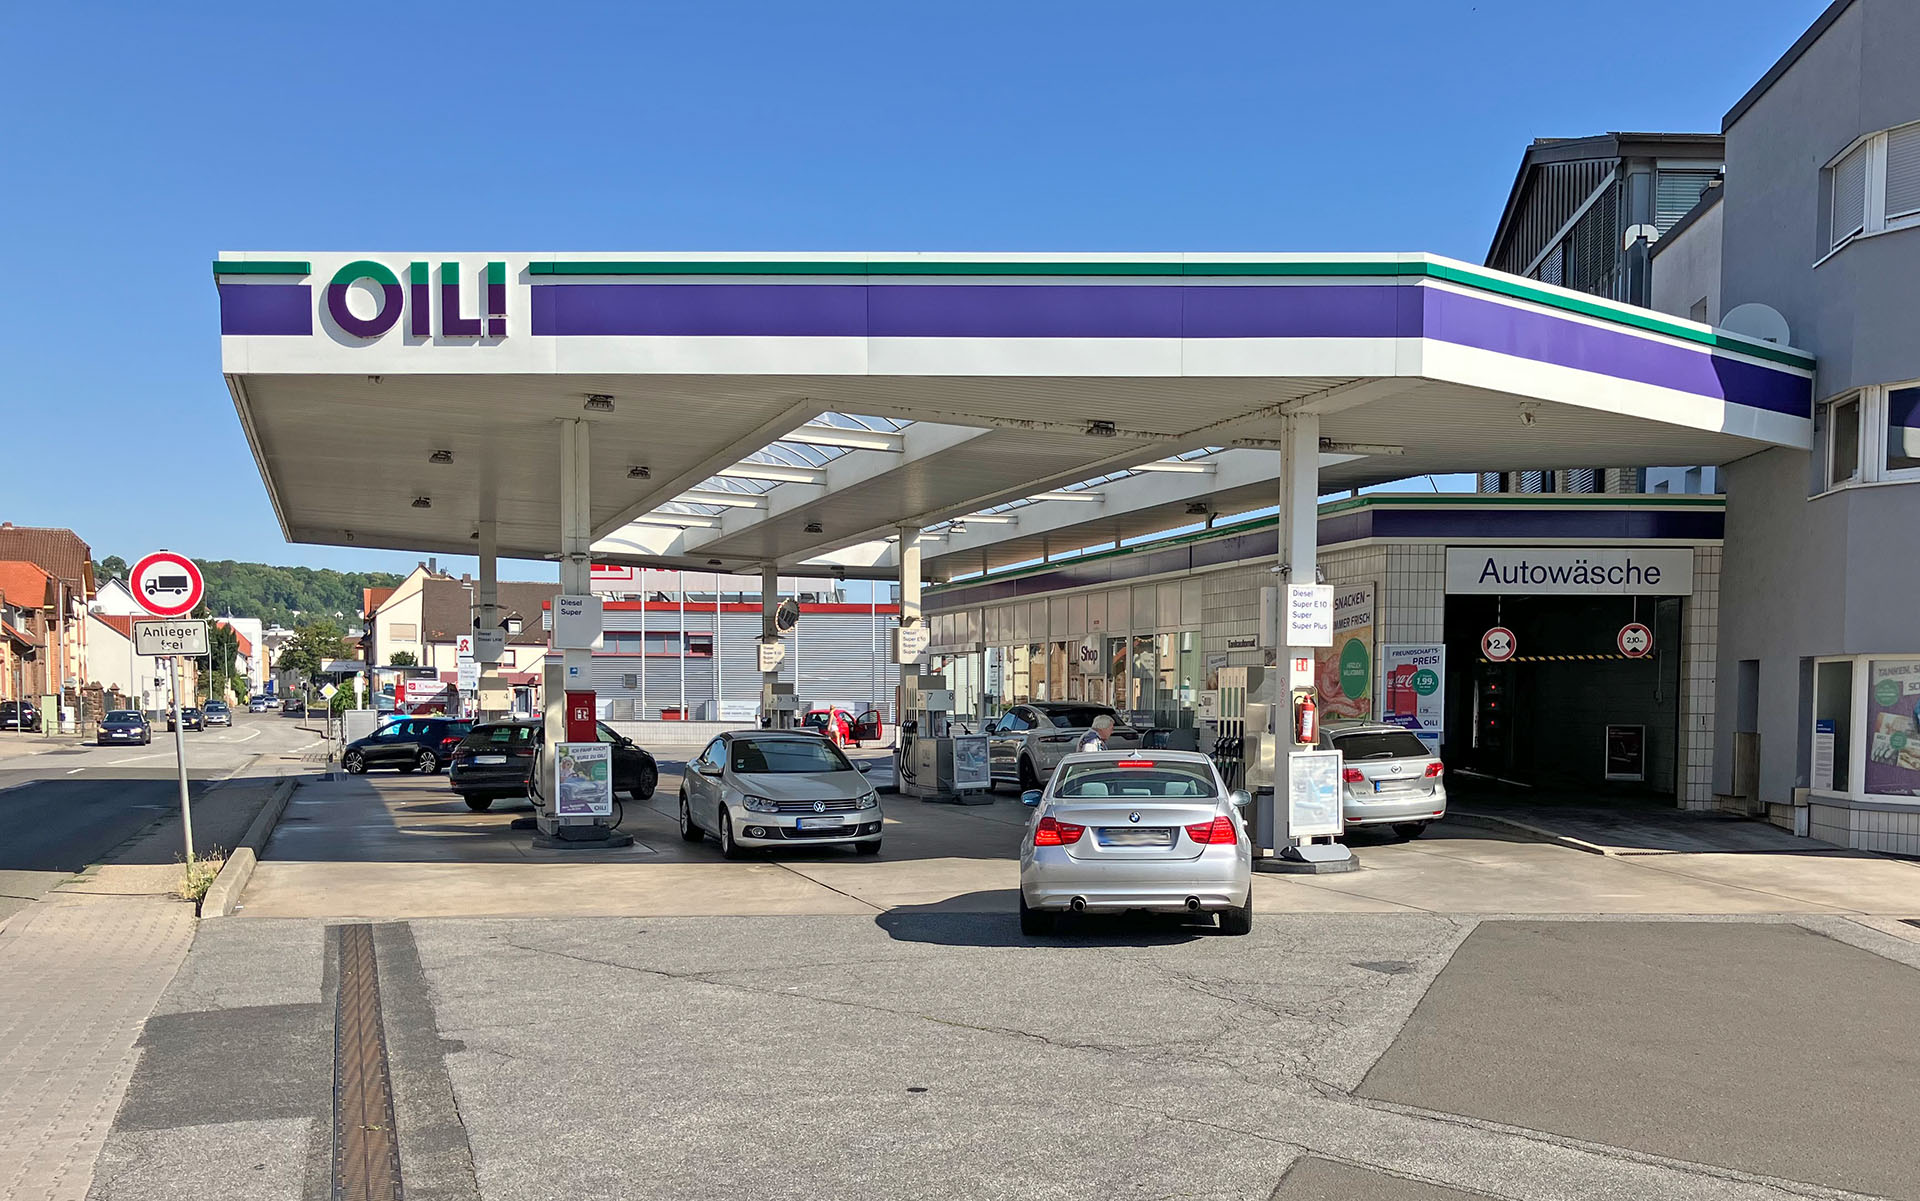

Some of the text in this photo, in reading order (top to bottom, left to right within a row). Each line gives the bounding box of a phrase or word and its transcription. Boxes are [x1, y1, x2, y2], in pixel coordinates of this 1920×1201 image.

[327, 260, 507, 338] OIL!
[1479, 557, 1661, 585] Autowäsche
[1292, 589, 1313, 597] Diesel
[1292, 600, 1312, 608] Super
[1334, 591, 1365, 610] SNACKEN
[560, 608, 582, 616] Super
[1292, 611, 1312, 619] Super
[1351, 612, 1370, 626] FRISCH
[1292, 622, 1327, 630] Super Plus
[143, 626, 198, 638] Anlieger
[161, 640, 183, 650] frei
[1081, 646, 1098, 665] Shop
[1392, 649, 1440, 657] FREUNDSCHAFTS-
[1412, 656, 1440, 665] PREIS!
